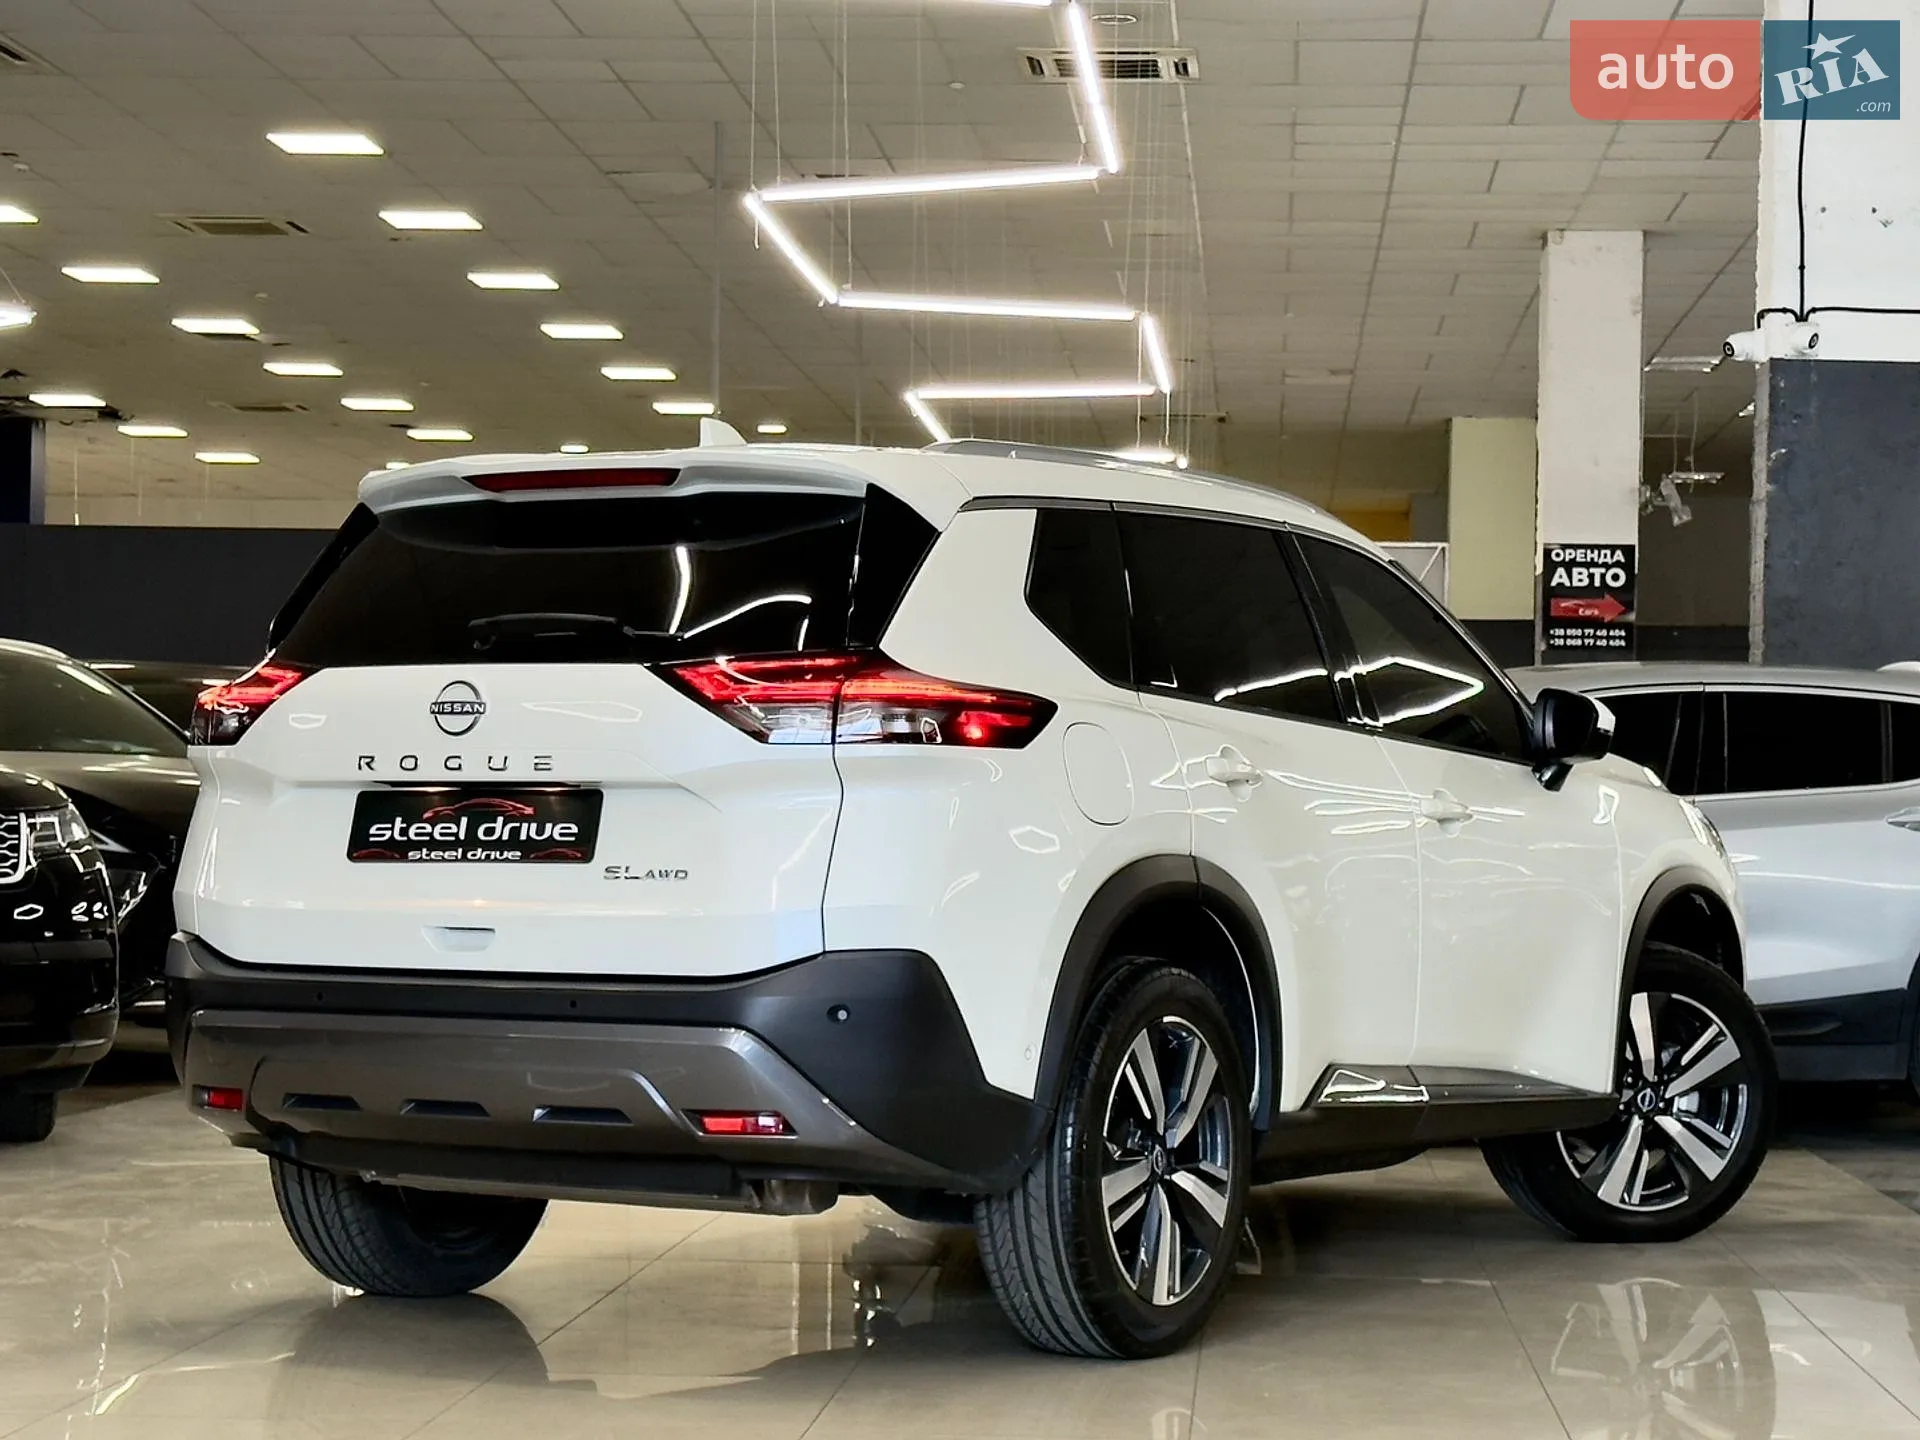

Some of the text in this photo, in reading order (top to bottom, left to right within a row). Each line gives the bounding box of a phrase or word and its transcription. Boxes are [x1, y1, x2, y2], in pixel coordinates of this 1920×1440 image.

[1551, 549, 1625, 564] ОРЕНДА
[1550, 566, 1627, 588] АВТО
[1583, 628, 1595, 637] 77
[1583, 638, 1595, 647] 77
[430, 703, 485, 713] NISSAN
[358, 754, 553, 772] ROGUE
[368, 816, 579, 842] steel drive
[407, 848, 522, 860] steel drive
